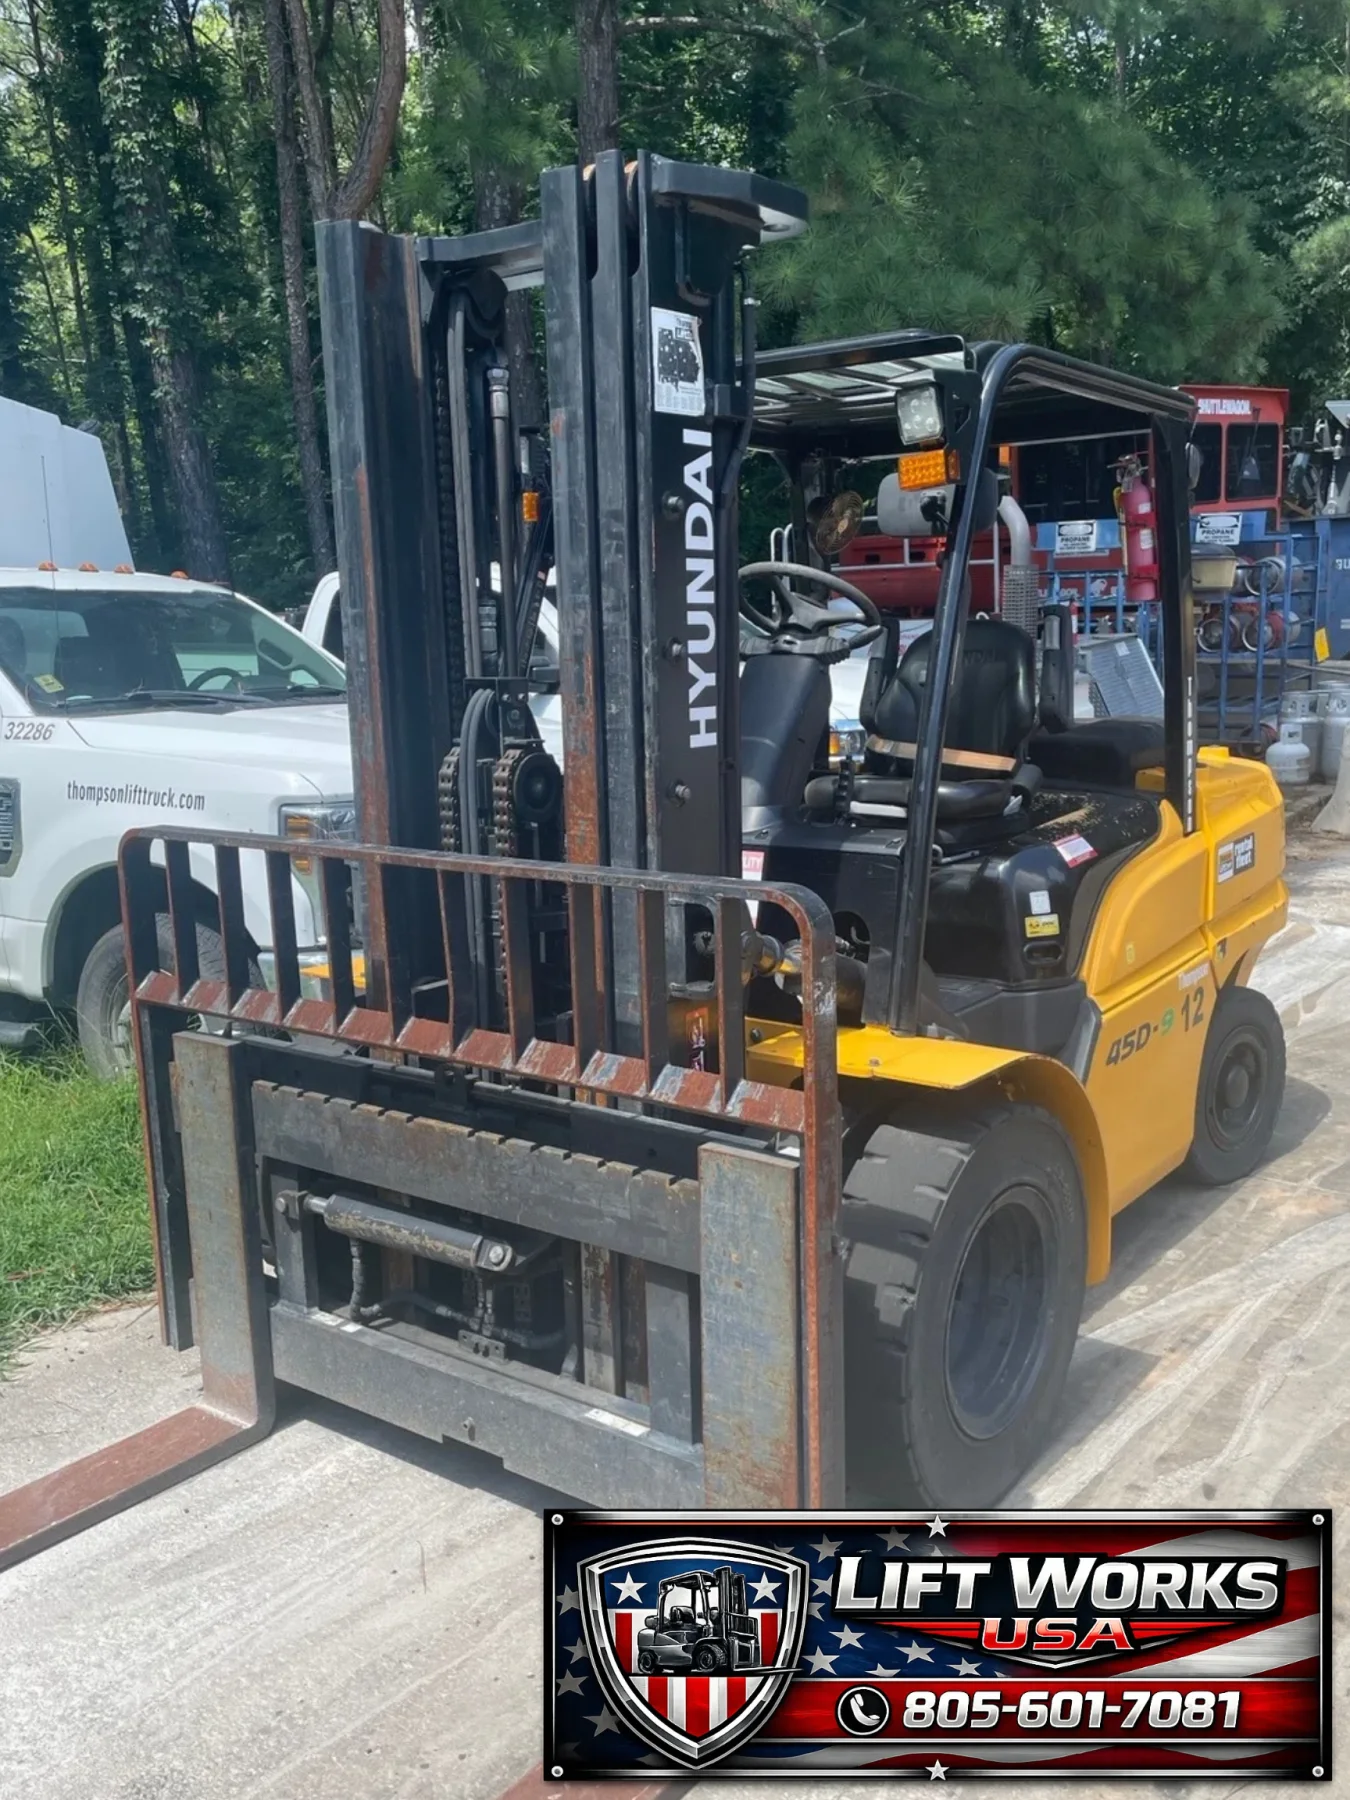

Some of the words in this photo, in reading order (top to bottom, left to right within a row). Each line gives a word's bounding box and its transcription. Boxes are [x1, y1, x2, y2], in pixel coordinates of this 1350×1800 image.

[1060, 536, 1091, 544] PROPANE
[682, 428, 717, 748] HYUNDAI
[4, 721, 55, 741] 32286
[67, 780, 205, 811] thompsonlifttruck.com
[1181, 986, 1205, 1032] 12
[1106, 1008, 1175, 1066] 45D-9
